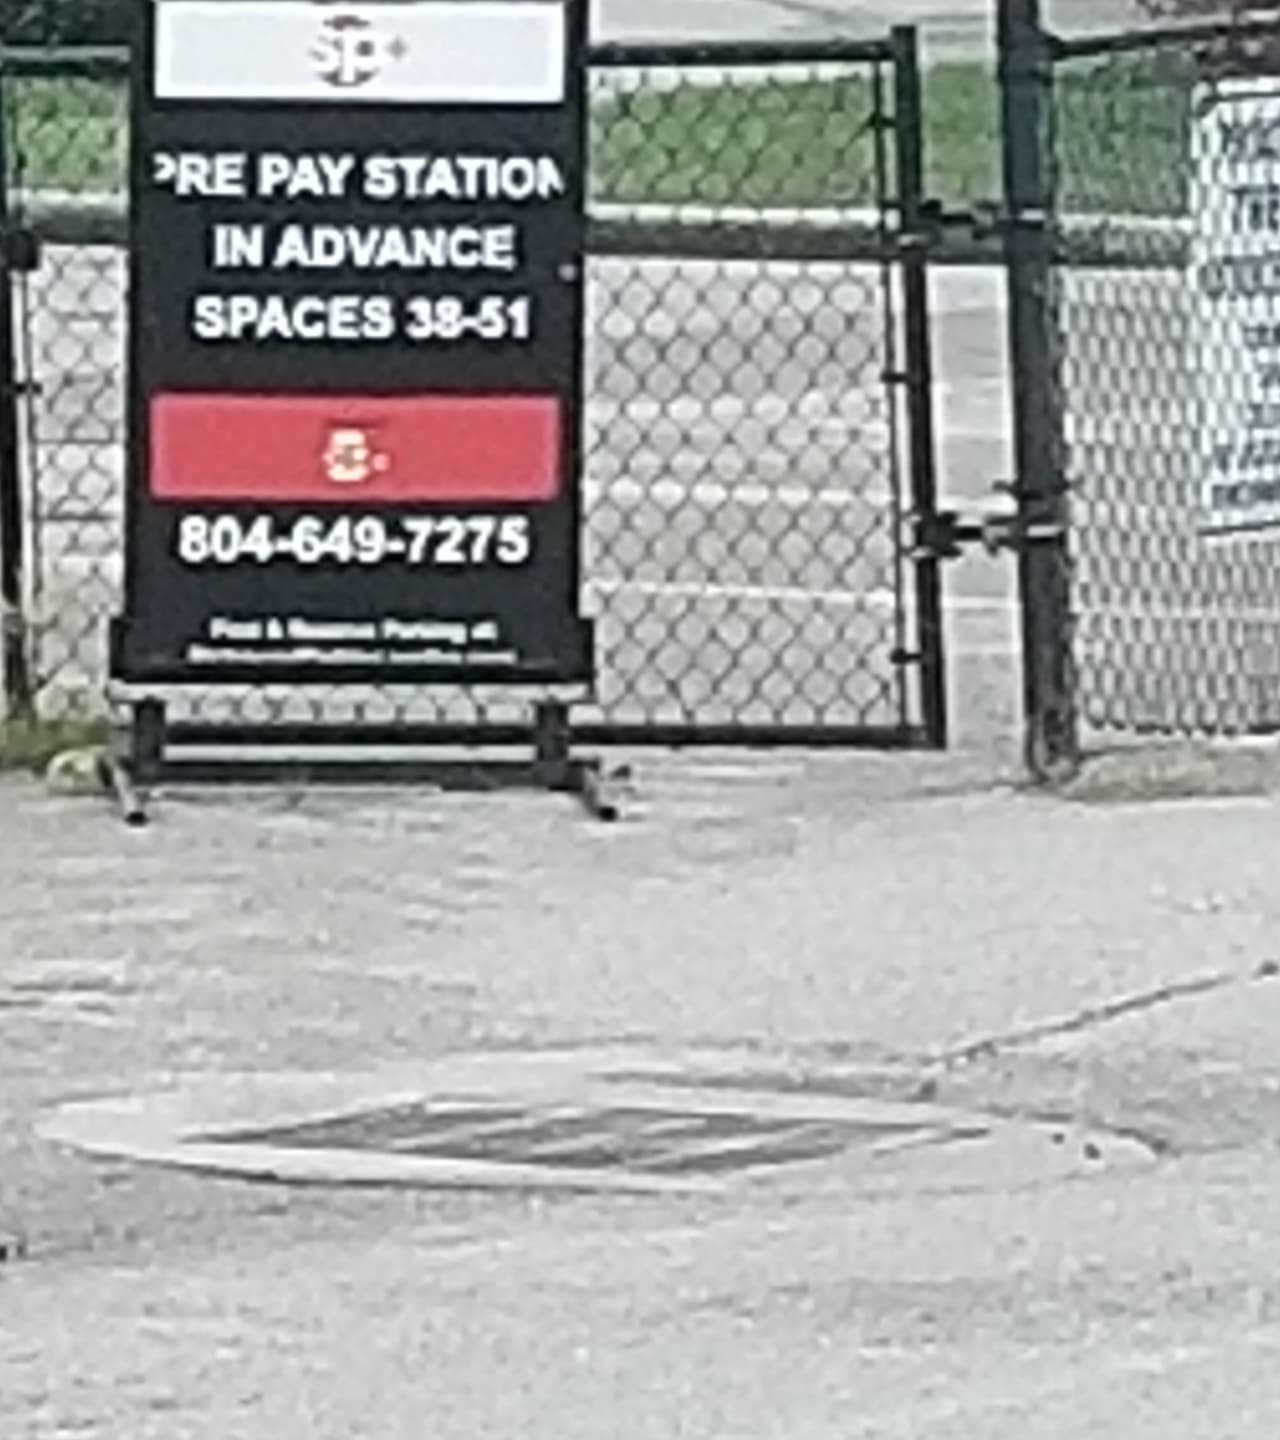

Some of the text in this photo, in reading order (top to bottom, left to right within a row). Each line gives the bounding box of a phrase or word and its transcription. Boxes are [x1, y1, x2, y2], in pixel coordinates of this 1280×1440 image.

[153, 152, 566, 198] PRE PAY STATION
[214, 222, 517, 270] IN ADVANCE
[192, 294, 395, 340] SPACES
[178, 515, 529, 563] 804-649-7275
